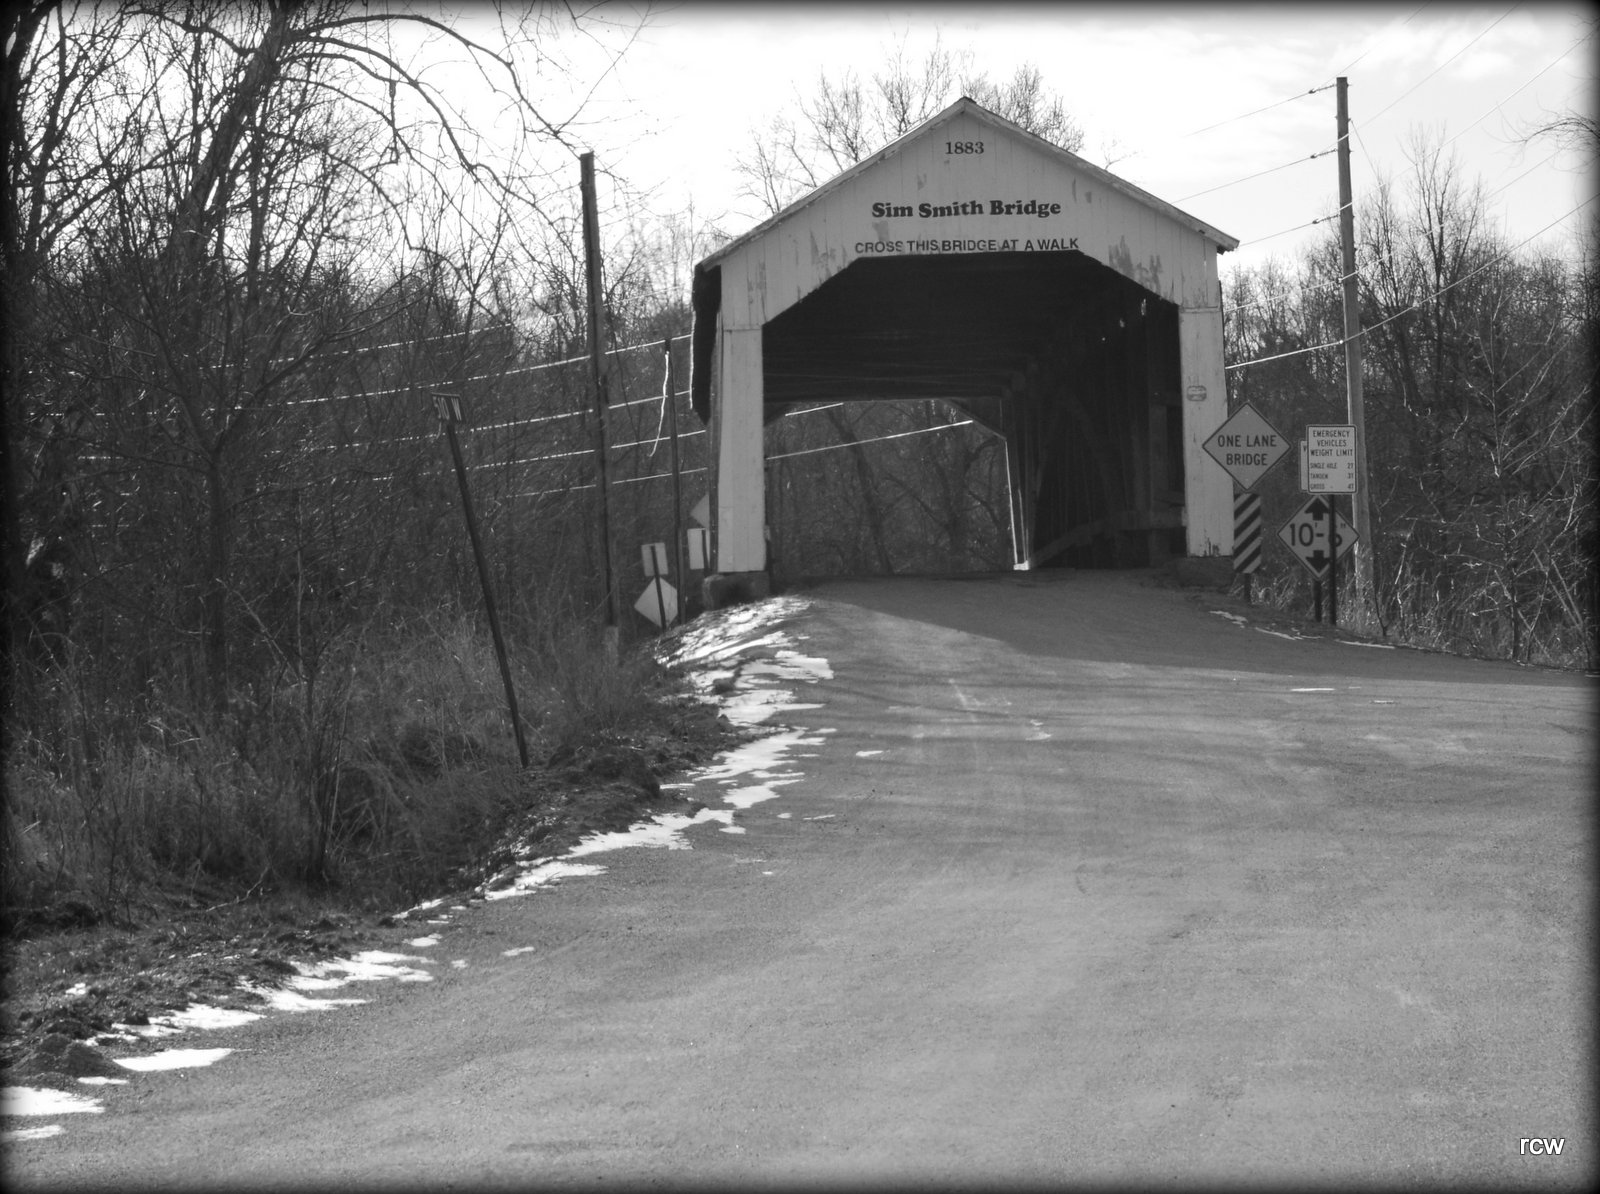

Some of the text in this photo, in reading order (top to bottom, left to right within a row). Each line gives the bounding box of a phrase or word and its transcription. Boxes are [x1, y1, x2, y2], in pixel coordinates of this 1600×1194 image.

[945, 141, 985, 155] 1883
[871, 199, 1062, 219] Sim Smith Bridge
[855, 238, 1079, 253] CROSS THIS BRIDGE AT A WALK
[1312, 430, 1351, 438] EMERGENCY
[1217, 434, 1278, 448] ONE LANE
[1316, 439, 1347, 447] VEHICLES
[1226, 453, 1268, 466] BRIDGE
[1310, 449, 1353, 457] WEIGHT LIMIT
